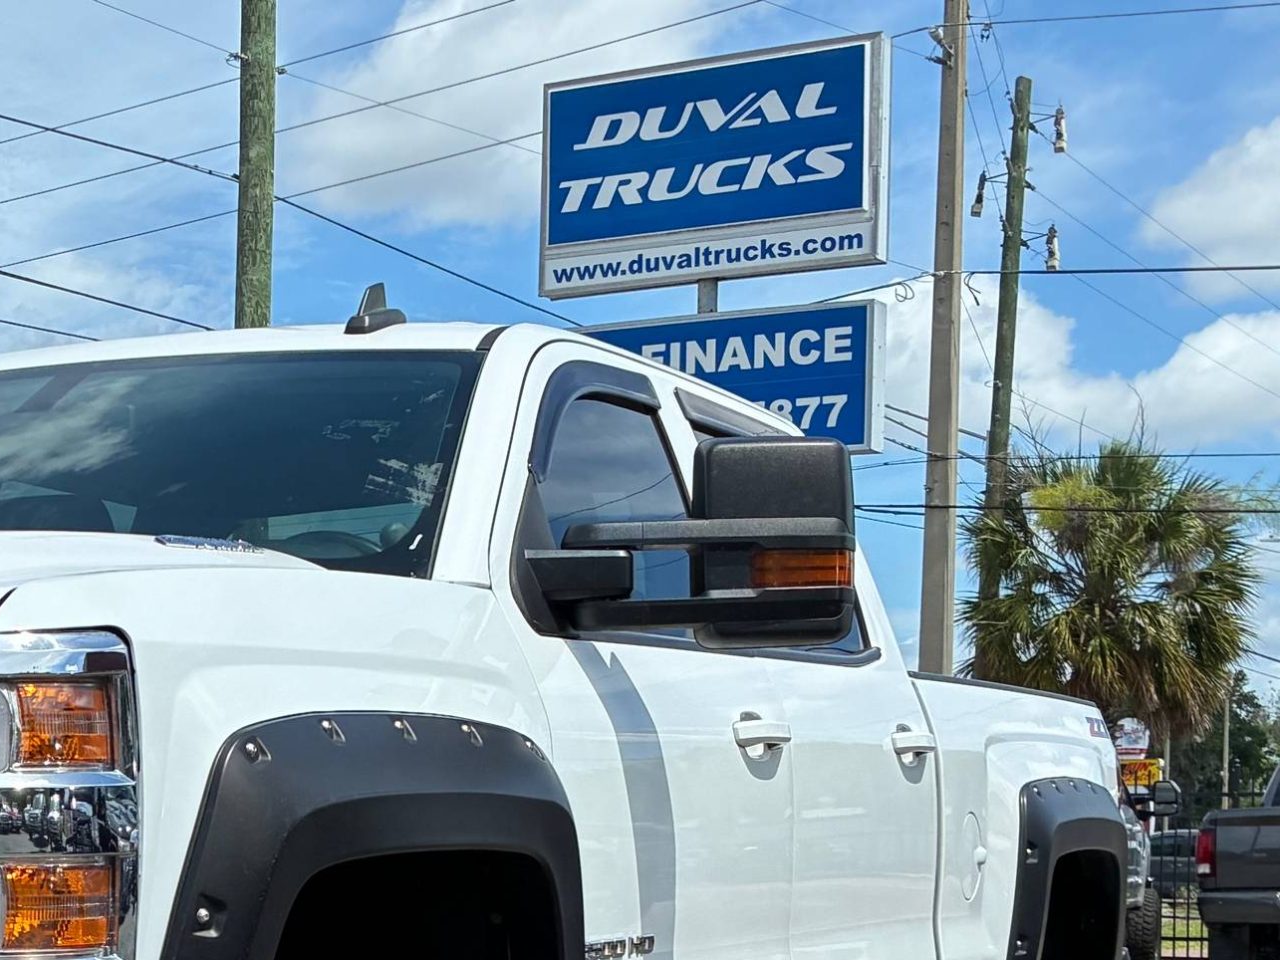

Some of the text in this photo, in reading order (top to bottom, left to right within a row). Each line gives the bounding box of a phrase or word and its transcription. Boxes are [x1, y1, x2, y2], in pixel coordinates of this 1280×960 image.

[573, 82, 838, 150] DUVAL
[559, 142, 853, 213] TRUCKS
[553, 232, 864, 283] www.duvaltrucks.com
[641, 326, 853, 375] FINANCE
[752, 394, 848, 430] 877
